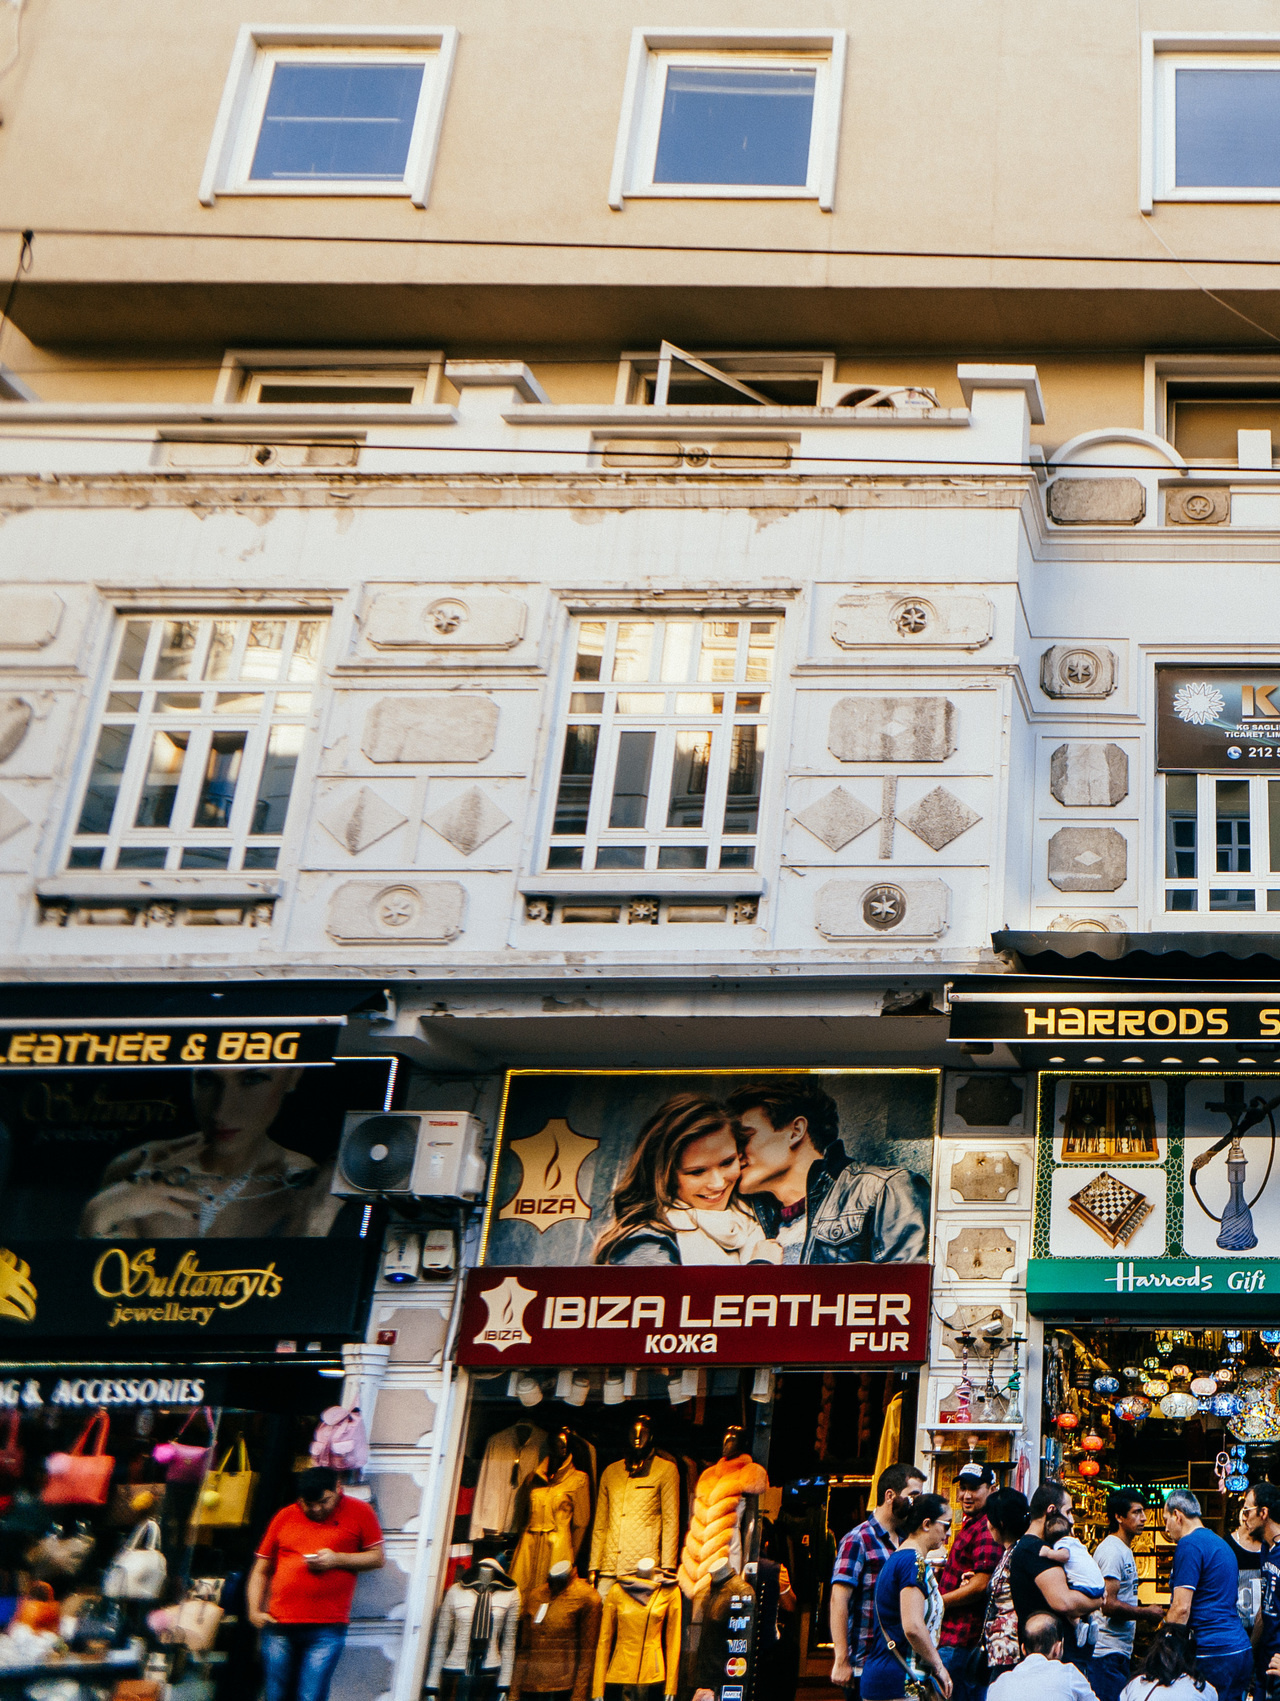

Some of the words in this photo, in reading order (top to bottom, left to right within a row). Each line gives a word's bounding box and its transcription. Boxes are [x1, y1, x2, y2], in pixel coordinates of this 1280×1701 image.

[1248, 747, 1273, 758] 212
[0, 1032, 171, 1063] EATHER
[180, 1033, 208, 1061] &
[514, 1198, 577, 1215] IBIZA
[1104, 1261, 1213, 1292] Harrods
[1227, 1269, 1266, 1293] Gift
[108, 1302, 217, 1328] jewellery
[542, 1296, 666, 1329] IBIZA
[679, 1293, 912, 1327] LEATHER
[484, 1329, 523, 1341] IBIZA
[849, 1332, 910, 1353] FUR
[52, 1379, 205, 1403] ACCESSORIES
